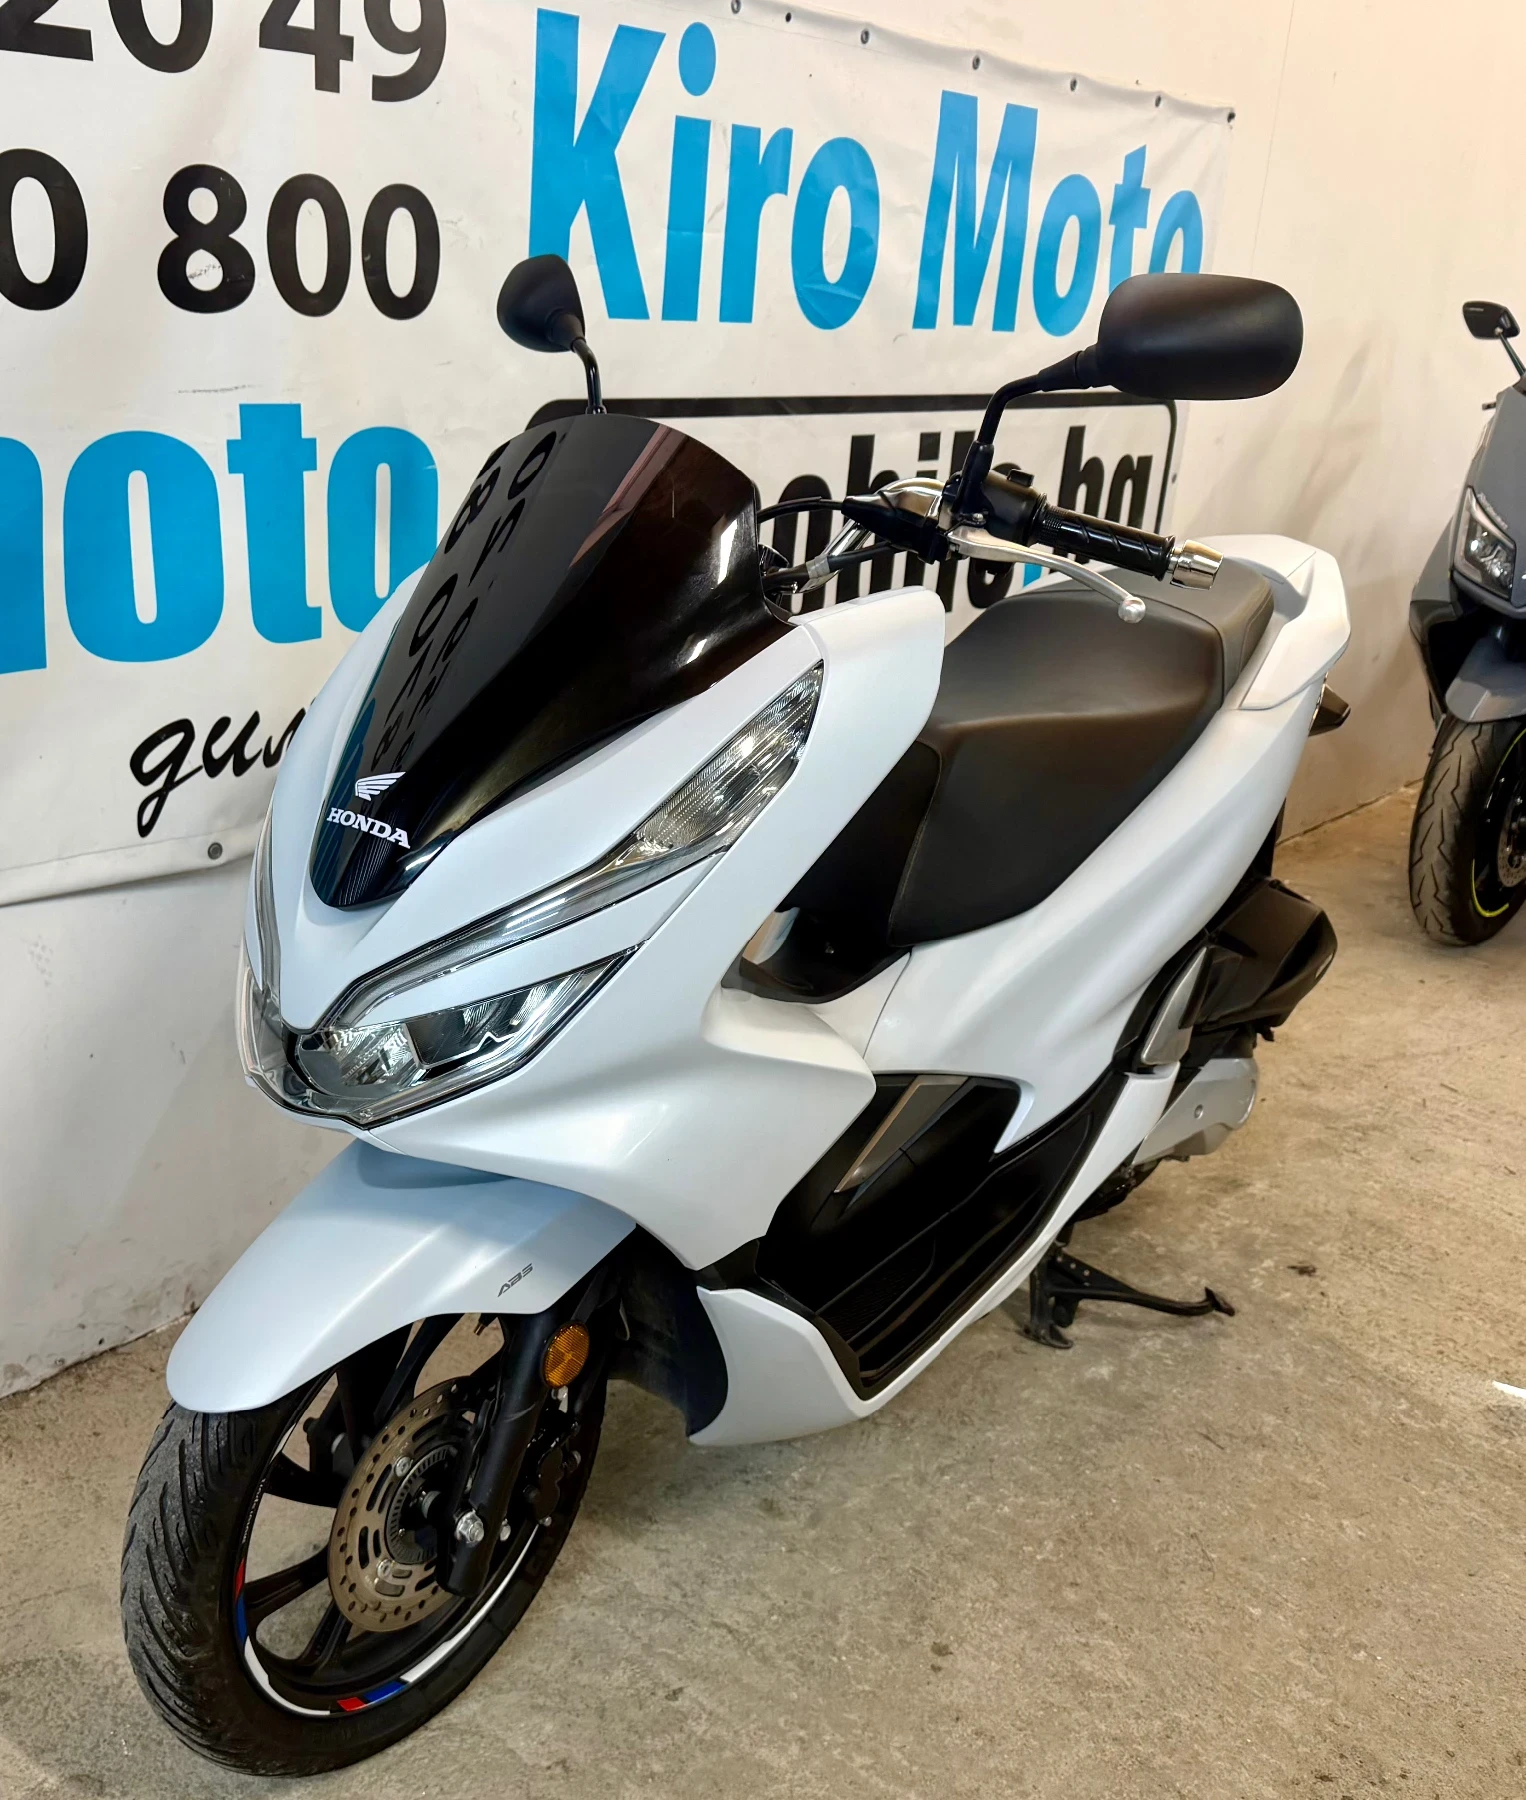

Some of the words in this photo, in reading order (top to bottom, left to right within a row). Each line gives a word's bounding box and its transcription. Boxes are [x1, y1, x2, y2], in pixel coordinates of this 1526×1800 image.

[259, 0, 446, 102] 49
[529, 8, 880, 330] Kiro
[912, 90, 1203, 337] Moto
[157, 164, 440, 320] 800
[0, 403, 438, 675] oto
[326, 807, 411, 849] HONDA
[497, 1262, 533, 1298] ABS
